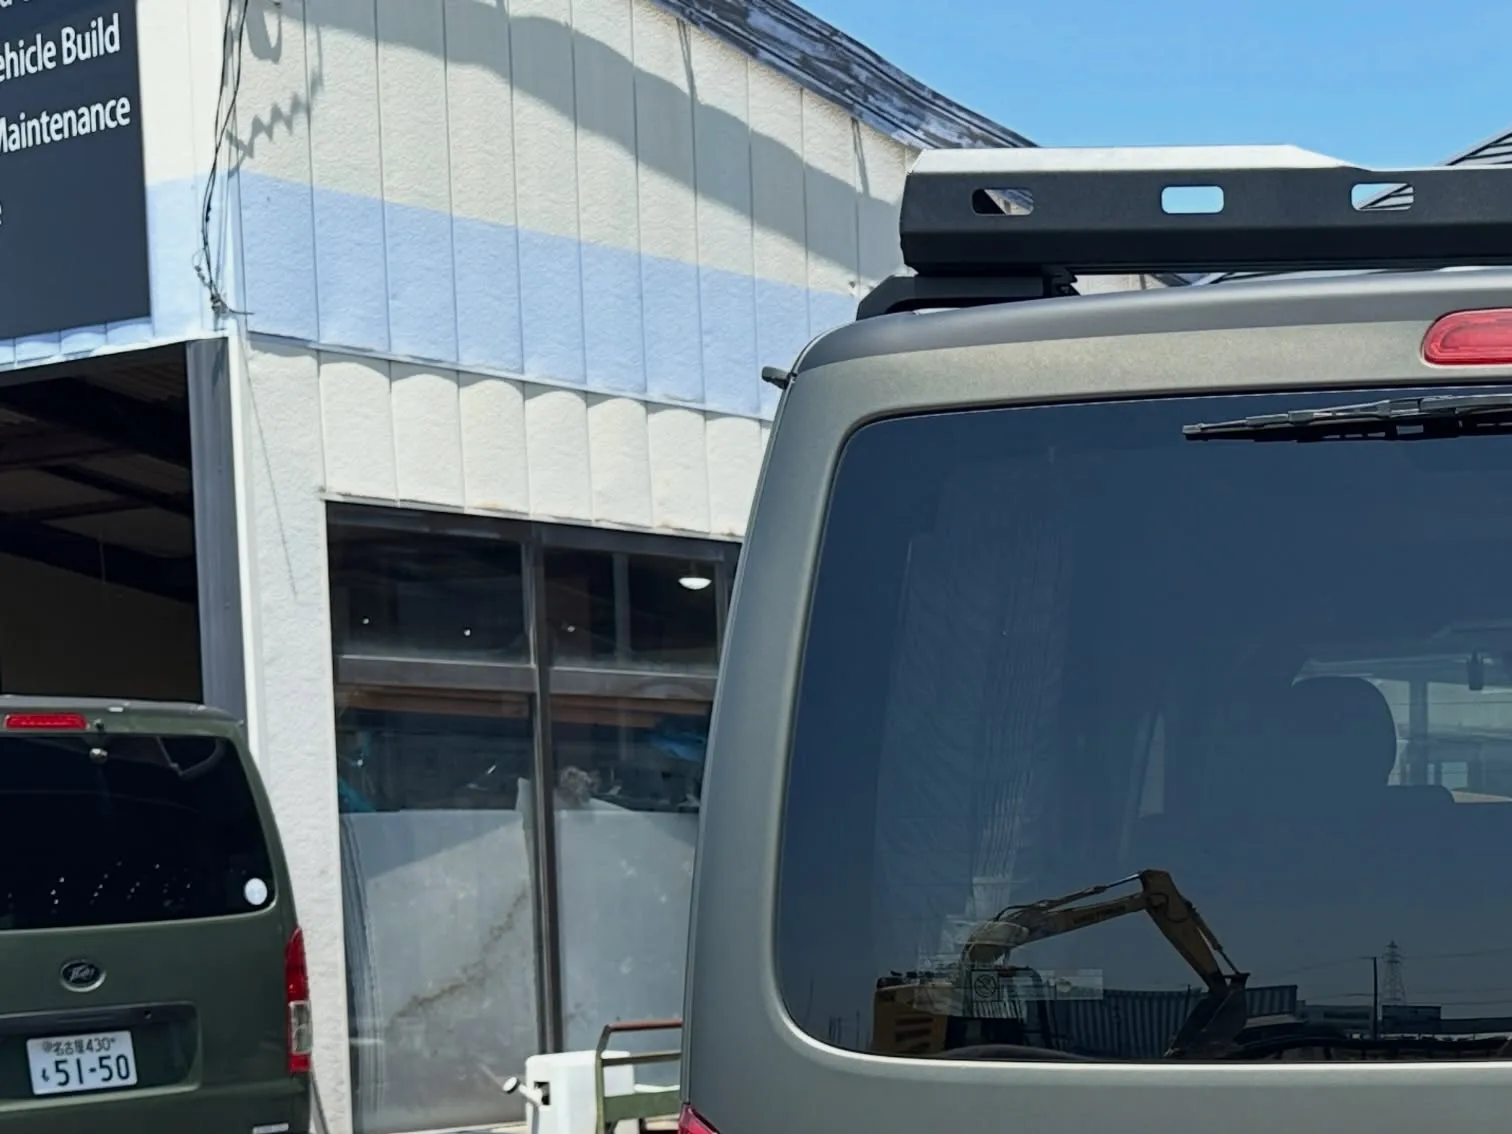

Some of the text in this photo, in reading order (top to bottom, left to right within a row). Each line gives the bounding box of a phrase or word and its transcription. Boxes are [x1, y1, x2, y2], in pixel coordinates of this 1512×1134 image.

[61, 12, 120, 65] Build
[86, 1037, 111, 1053] 430
[54, 1054, 130, 1086] 51-50
